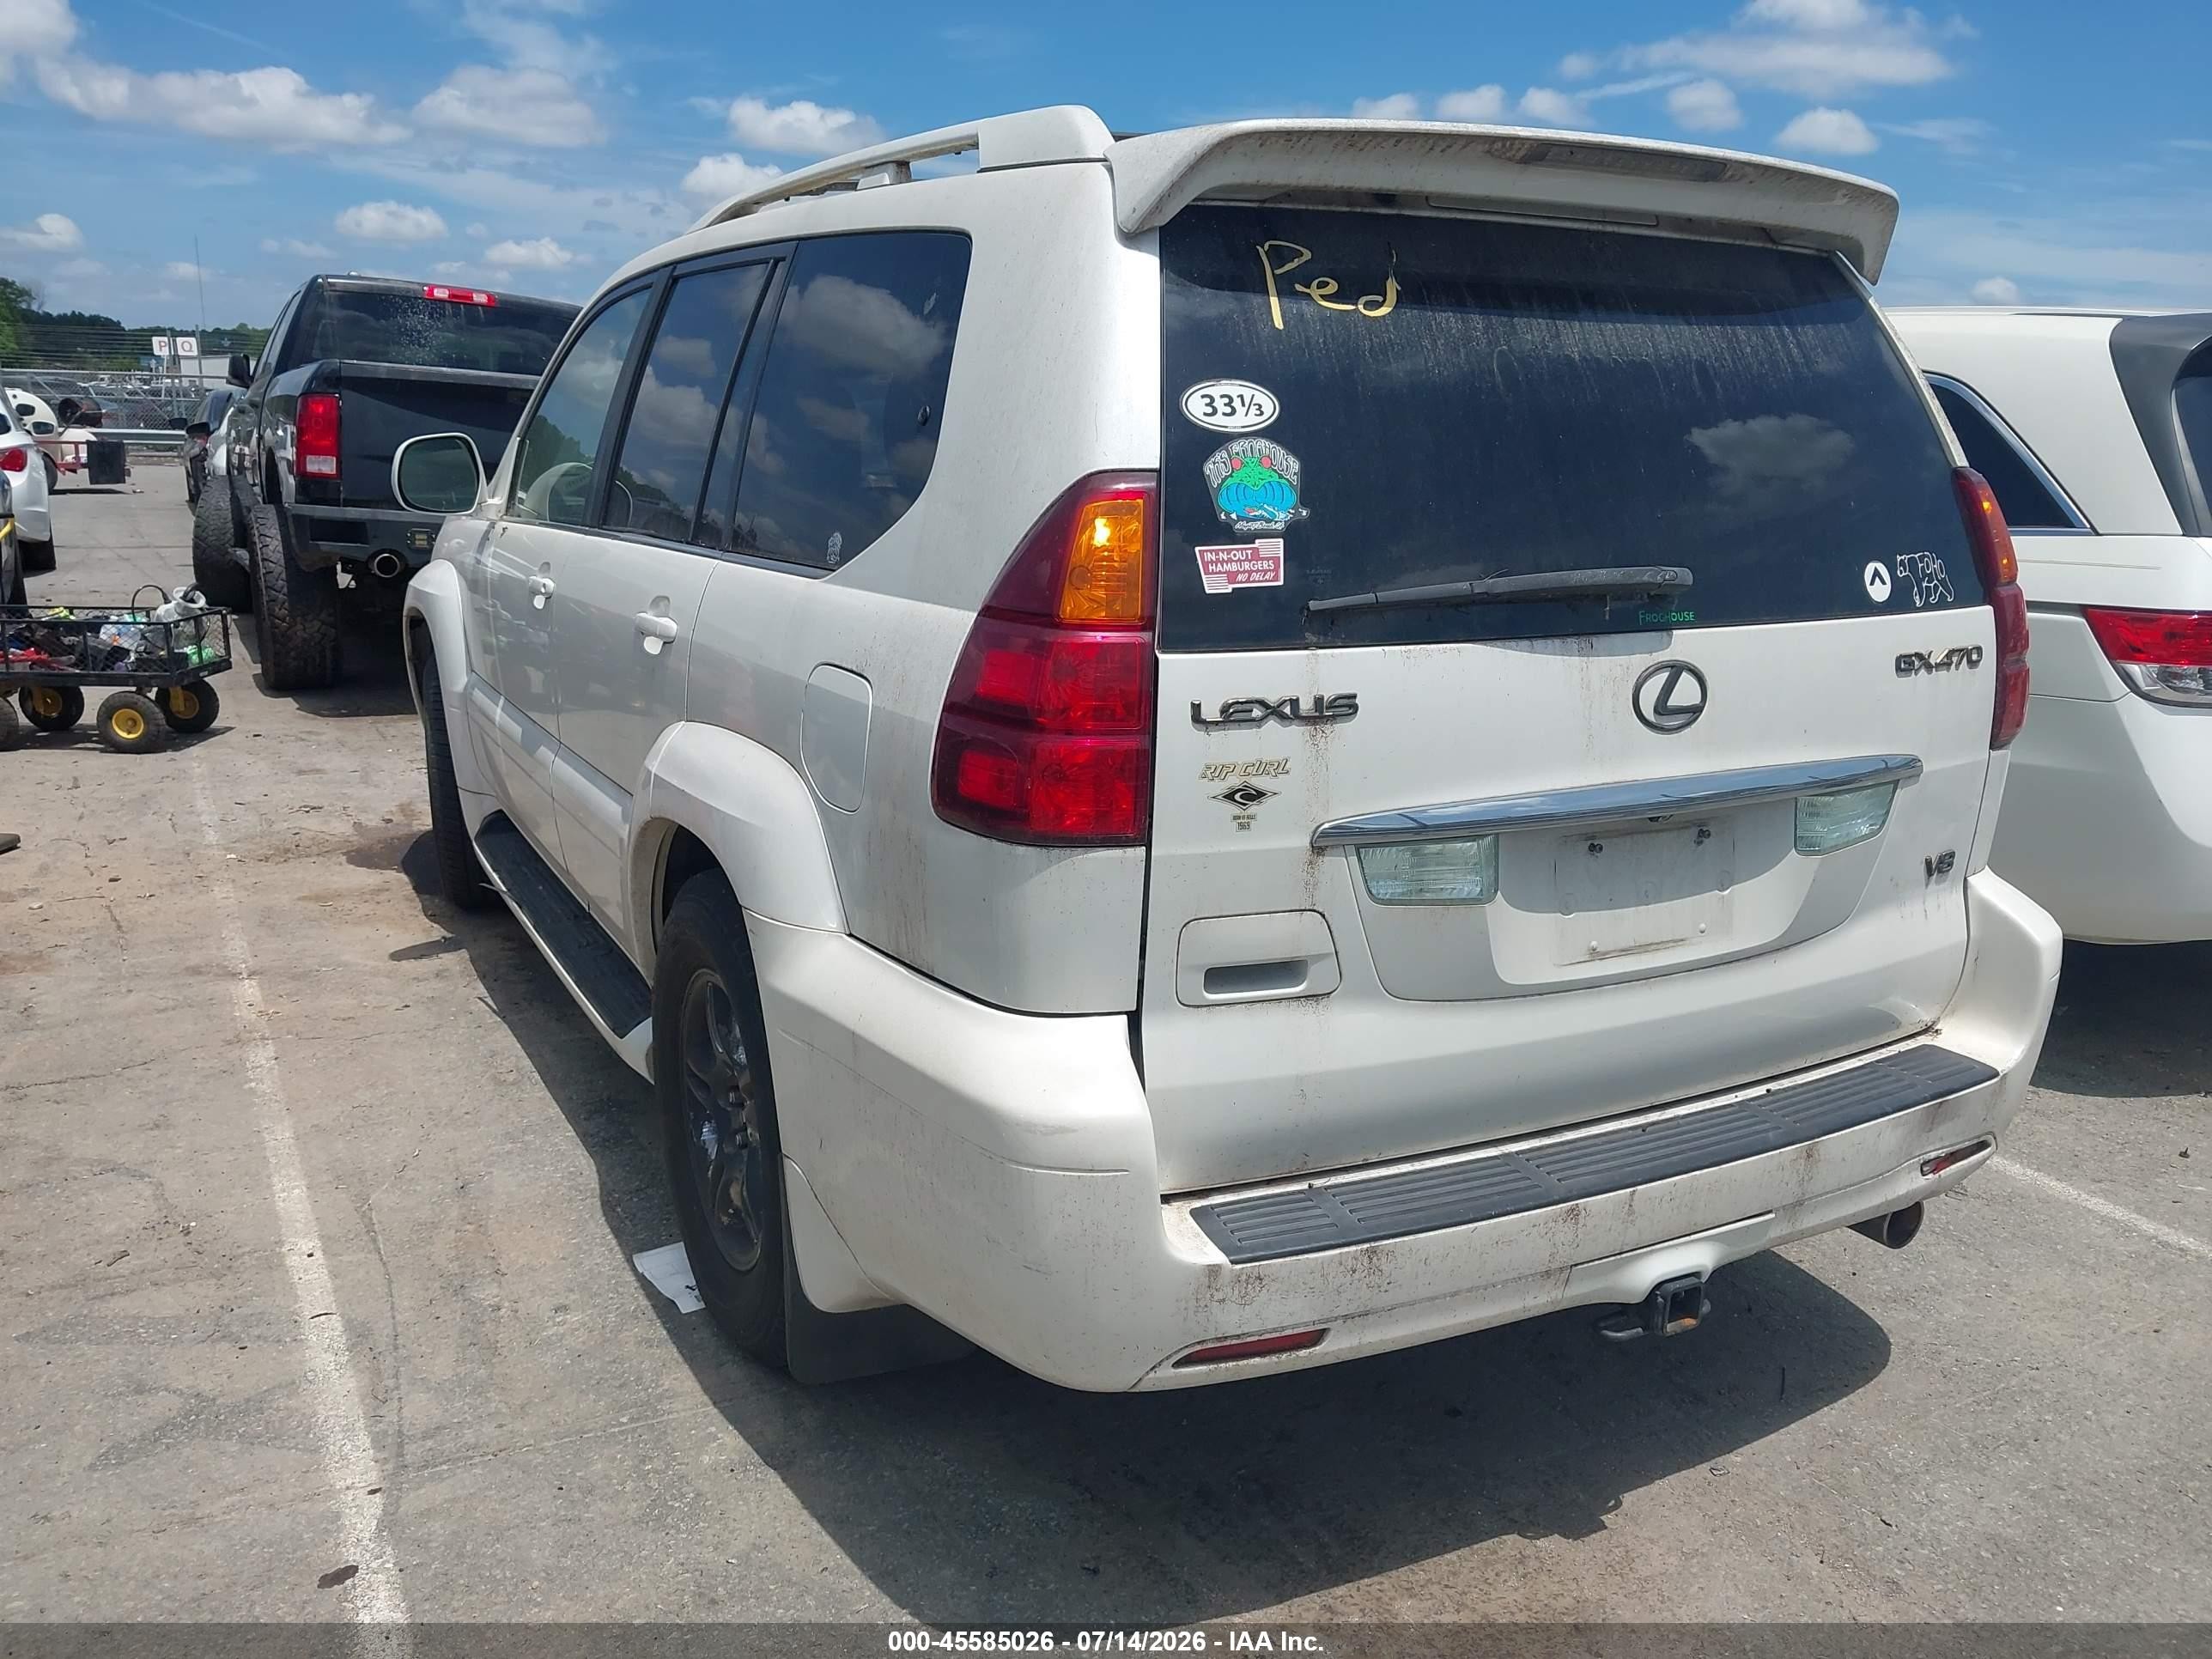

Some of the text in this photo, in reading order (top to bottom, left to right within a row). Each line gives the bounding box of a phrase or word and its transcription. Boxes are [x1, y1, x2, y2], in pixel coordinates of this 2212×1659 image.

[158, 340, 167, 352] P
[180, 340, 194, 352] Q
[1204, 550, 1253, 562] IN-N-OUT
[1208, 560, 1275, 573] HAMBURGERS
[1236, 571, 1276, 582] NO DELAY
[1638, 611, 1696, 625] FROGHOUSE
[1190, 693, 1359, 726] LEXUS
[1200, 758, 1290, 781] RIP CURL
[1237, 821, 1250, 830] 1969
[1924, 849, 1955, 878] V8
